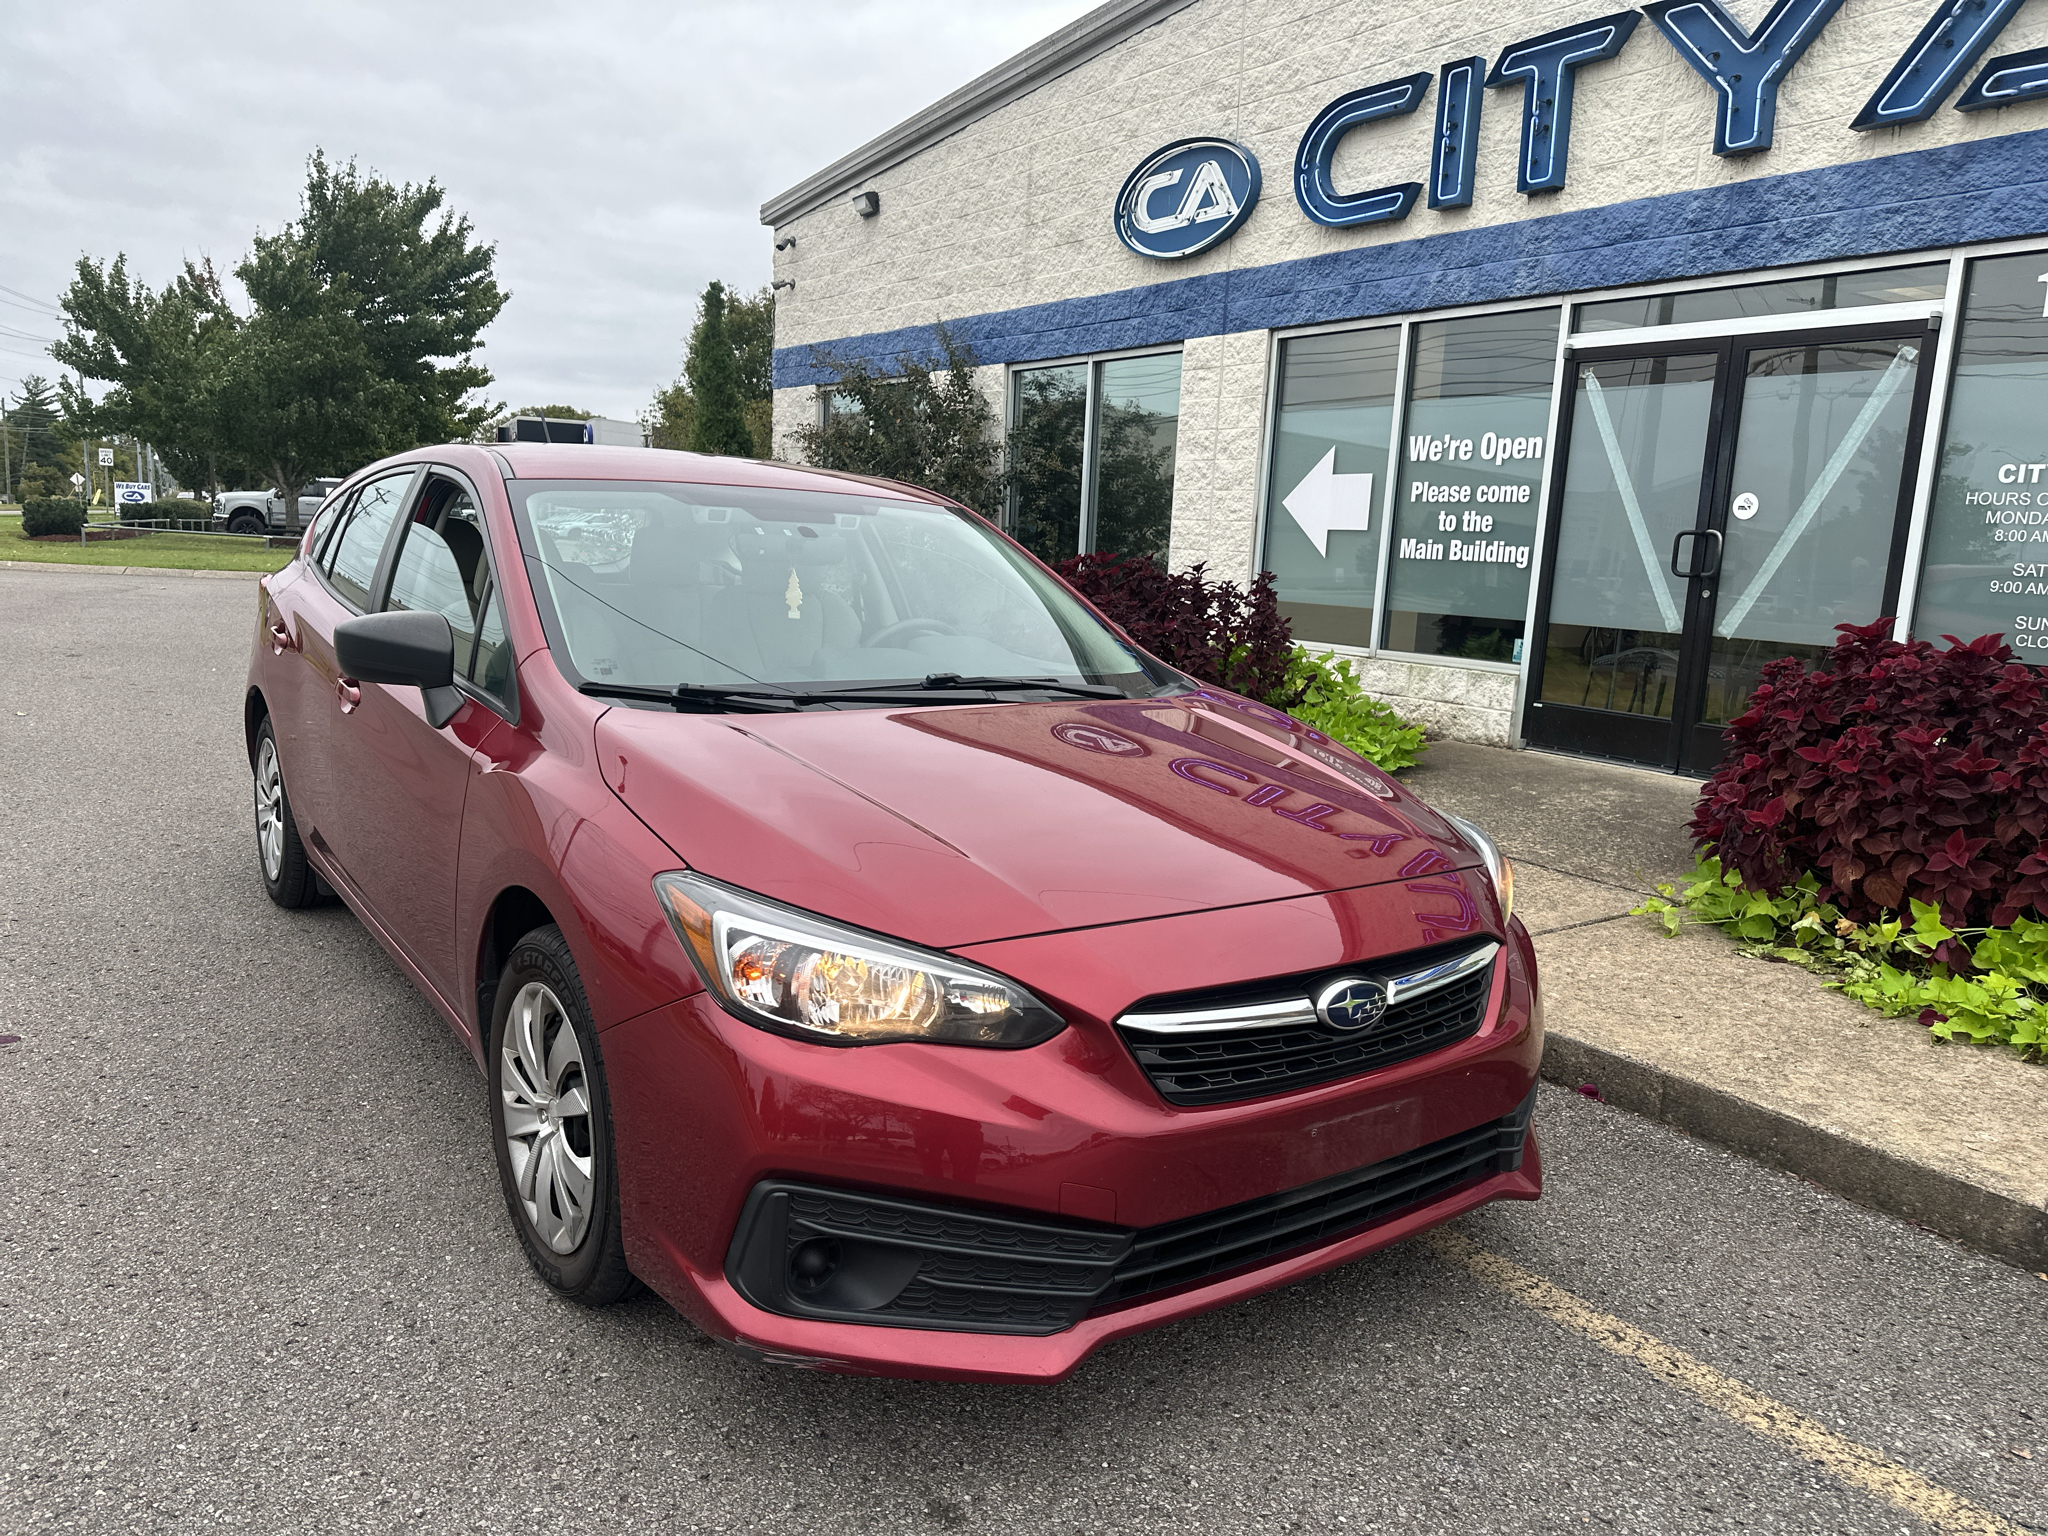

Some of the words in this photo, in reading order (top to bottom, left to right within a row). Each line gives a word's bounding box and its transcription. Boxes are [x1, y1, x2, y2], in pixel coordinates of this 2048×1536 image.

[1132, 160, 1240, 235] CA
[1409, 434, 1473, 462] We're
[1480, 431, 1543, 466] Open
[1998, 463, 2048, 484] CIT
[123, 492, 143, 500] CA
[1410, 481, 1471, 503] Please
[1476, 484, 1530, 503] come
[1965, 491, 2032, 506] HOURS
[1438, 510, 1457, 532] to
[1462, 510, 1493, 532] the
[1994, 529, 2027, 542] 8:00
[1400, 538, 1444, 560] Main
[1448, 539, 1530, 569] Building
[1989, 580, 2023, 594] 9:00
